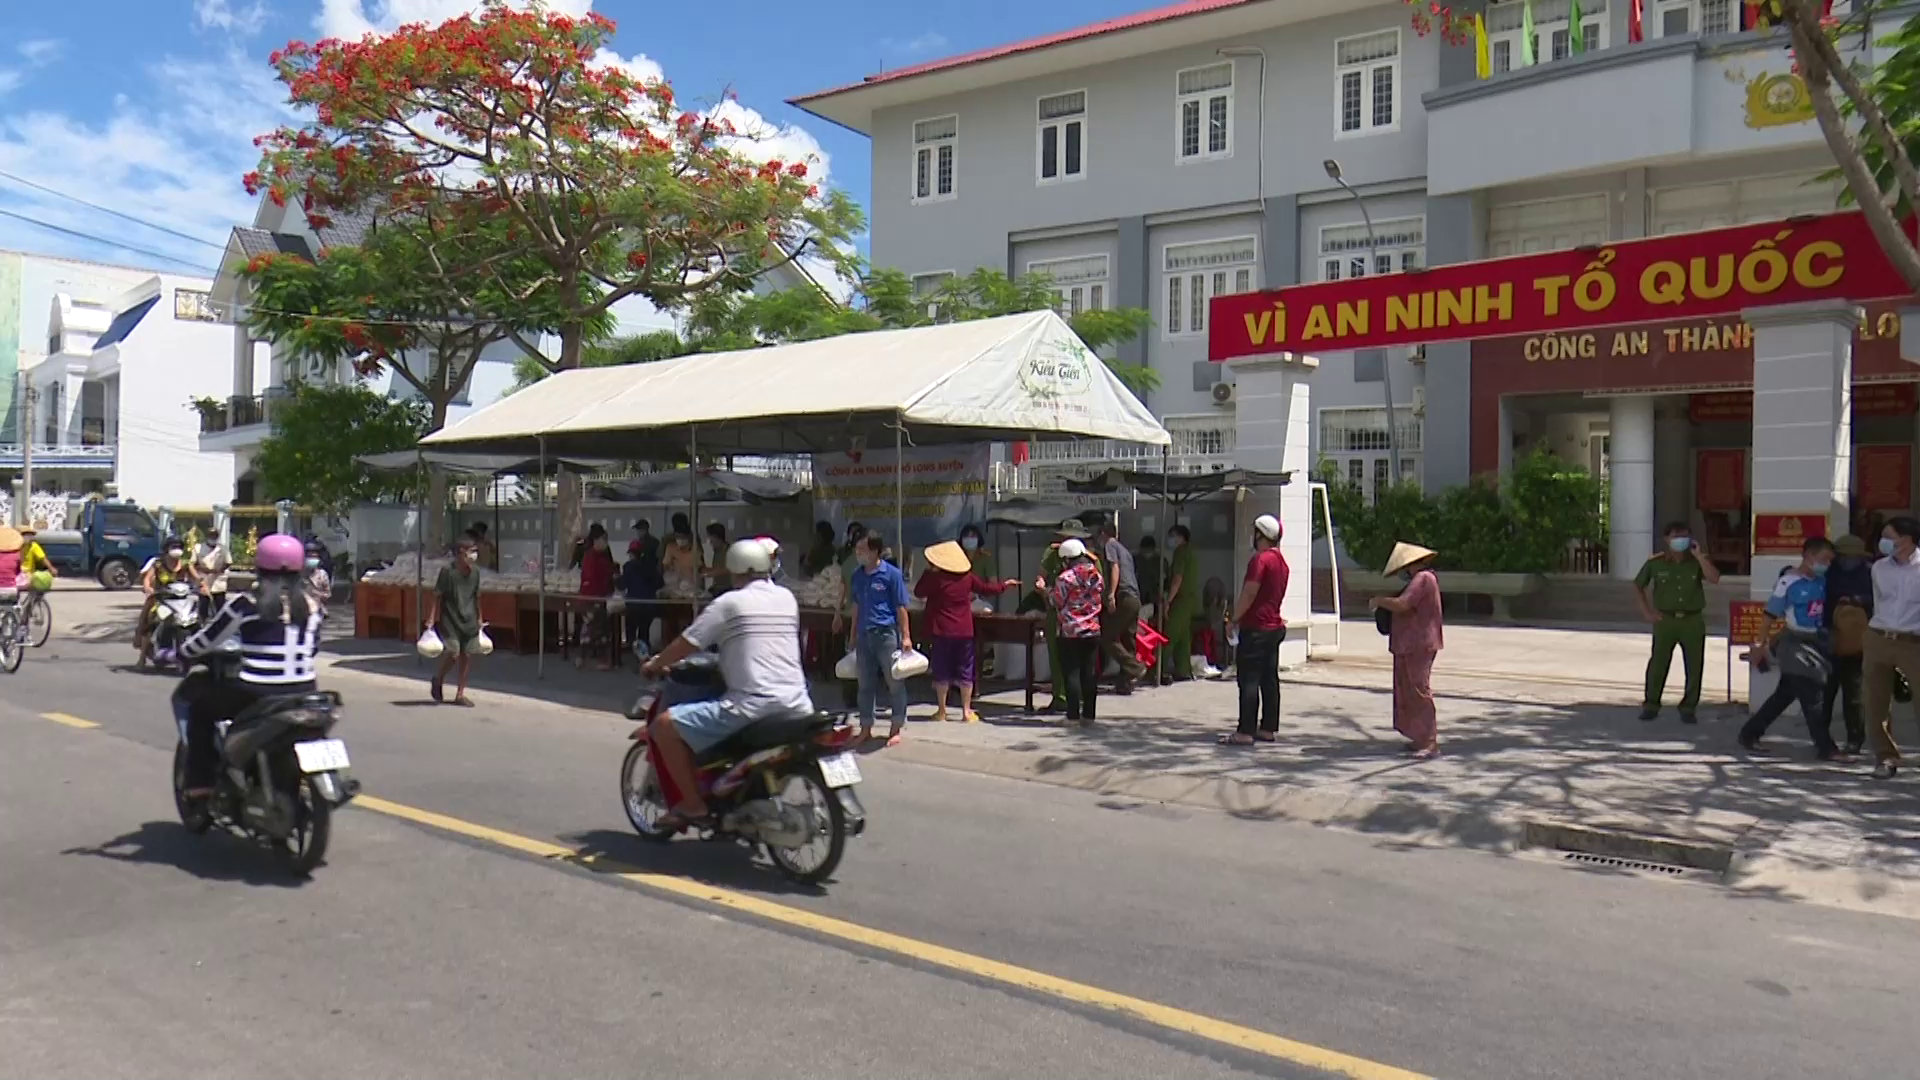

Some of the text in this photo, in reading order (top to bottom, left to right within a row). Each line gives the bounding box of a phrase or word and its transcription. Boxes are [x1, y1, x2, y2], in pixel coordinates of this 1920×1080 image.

[1244, 229, 1845, 345] VÌ AN NINH TỔ QUỐC
[1523, 333, 1596, 361] CÔNG
[1611, 330, 1648, 356] AN
